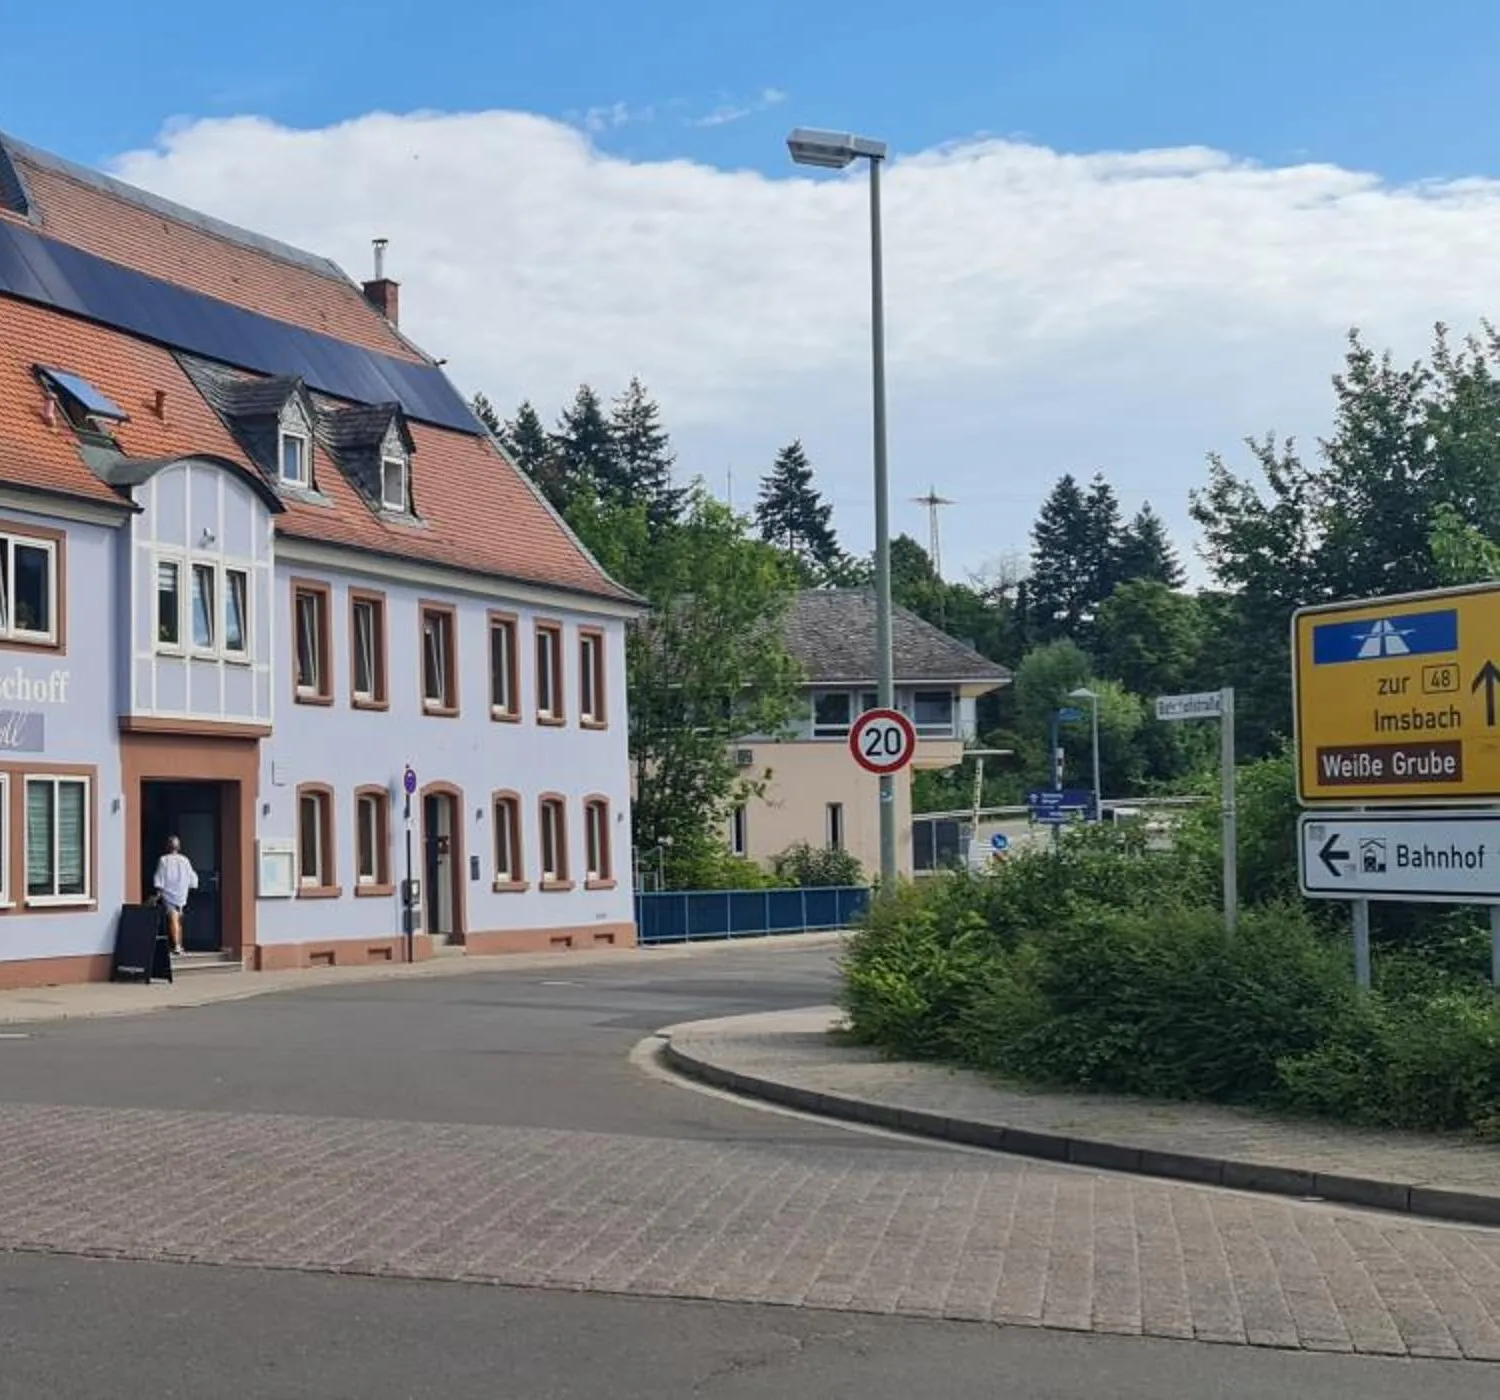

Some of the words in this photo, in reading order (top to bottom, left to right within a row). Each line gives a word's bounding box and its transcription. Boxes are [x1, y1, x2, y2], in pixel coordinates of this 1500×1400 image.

[1377, 676, 1411, 696] zur
[1431, 669, 1451, 688] 48
[1374, 703, 1461, 732] Imsbach
[865, 727, 901, 757] 20
[1321, 753, 1384, 778] Weiße
[1392, 749, 1456, 776] Grube
[1396, 844, 1485, 869] Bahnhof
